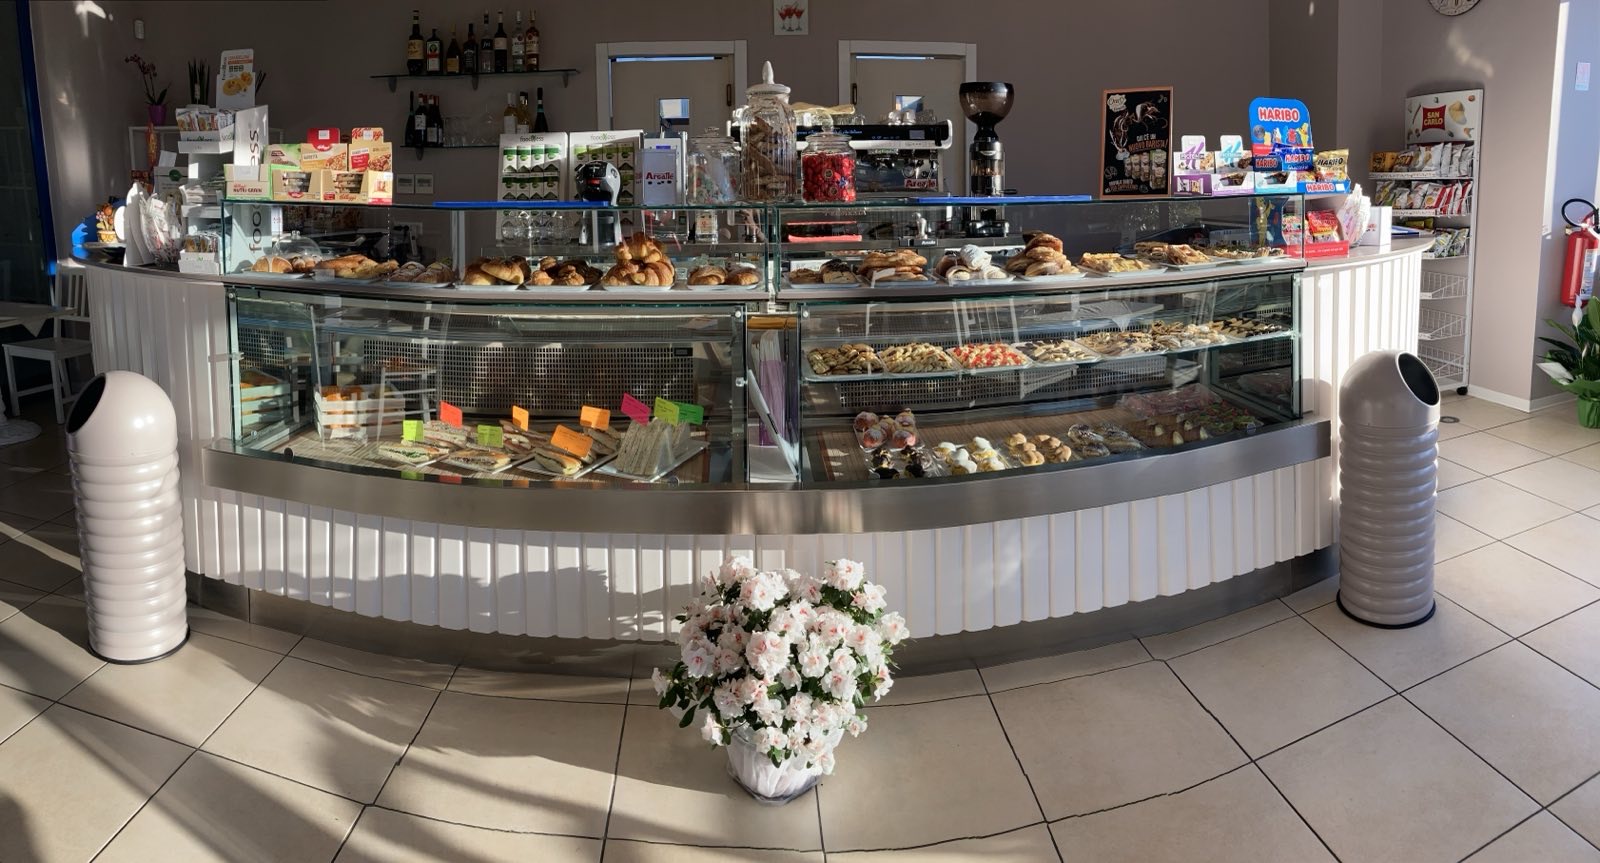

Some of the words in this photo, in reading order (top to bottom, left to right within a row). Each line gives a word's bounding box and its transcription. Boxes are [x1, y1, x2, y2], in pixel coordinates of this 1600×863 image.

[1258, 107, 1300, 121] HARIBO
[1256, 158, 1278, 168] HARIBO
[1285, 154, 1310, 163] HARIBO
[1317, 157, 1344, 166] HARIBO
[1306, 183, 1335, 192] HARIBO
[249, 205, 262, 253] foo
